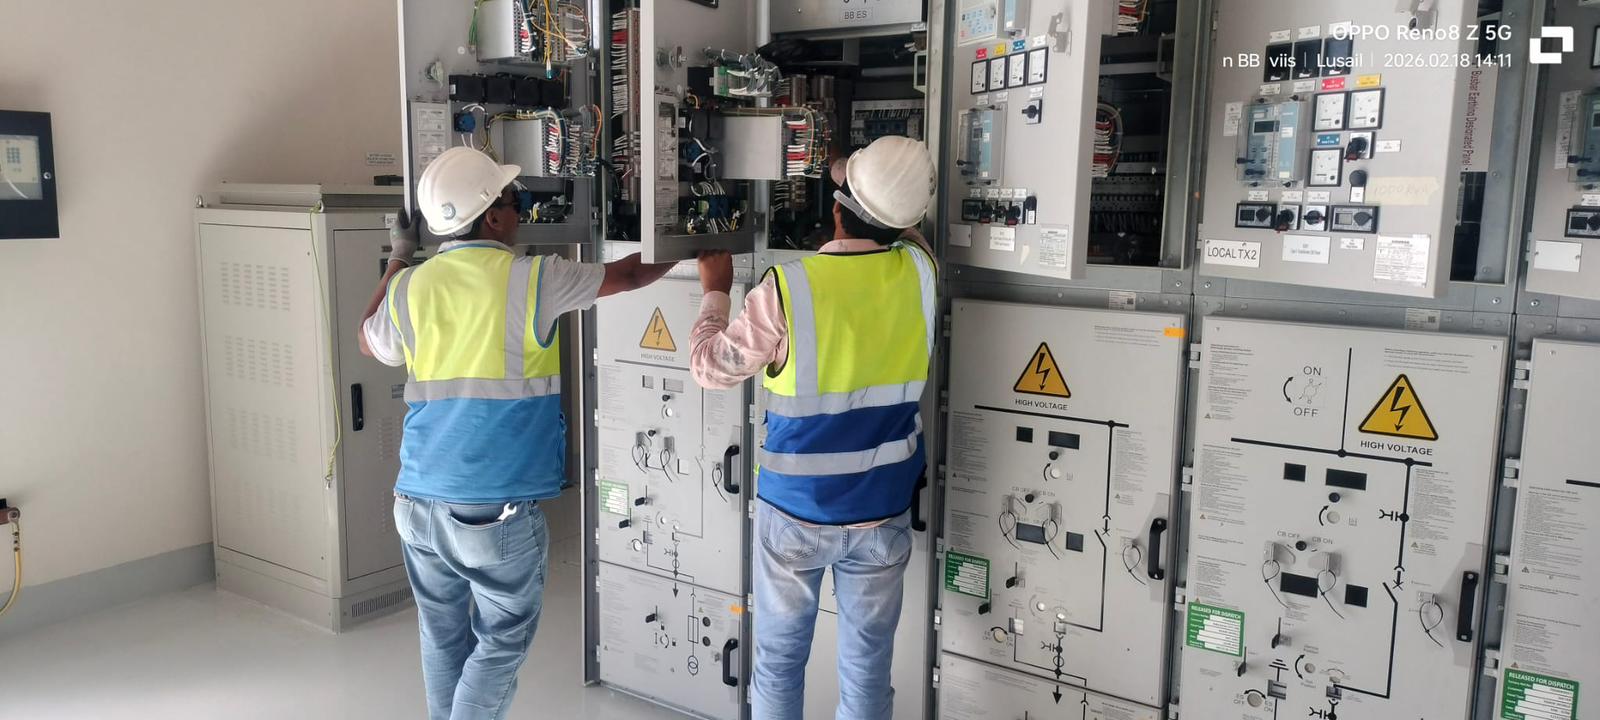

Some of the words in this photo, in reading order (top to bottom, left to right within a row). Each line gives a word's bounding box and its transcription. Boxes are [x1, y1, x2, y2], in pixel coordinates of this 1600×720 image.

[844, 11, 855, 20] BB
[856, 10, 867, 19] ES
[1238, 248, 1257, 260] TX2
[1303, 365, 1322, 376] ON
[1015, 398, 1033, 407] HIGH
[1034, 400, 1068, 411] VOLTAGE
[1293, 406, 1319, 417] OFF
[1360, 440, 1385, 451] HIGH
[1387, 443, 1433, 456] VOLTAGE
[1508, 672, 1535, 682] RELEASED
[1548, 679, 1575, 690] DISPATCH
